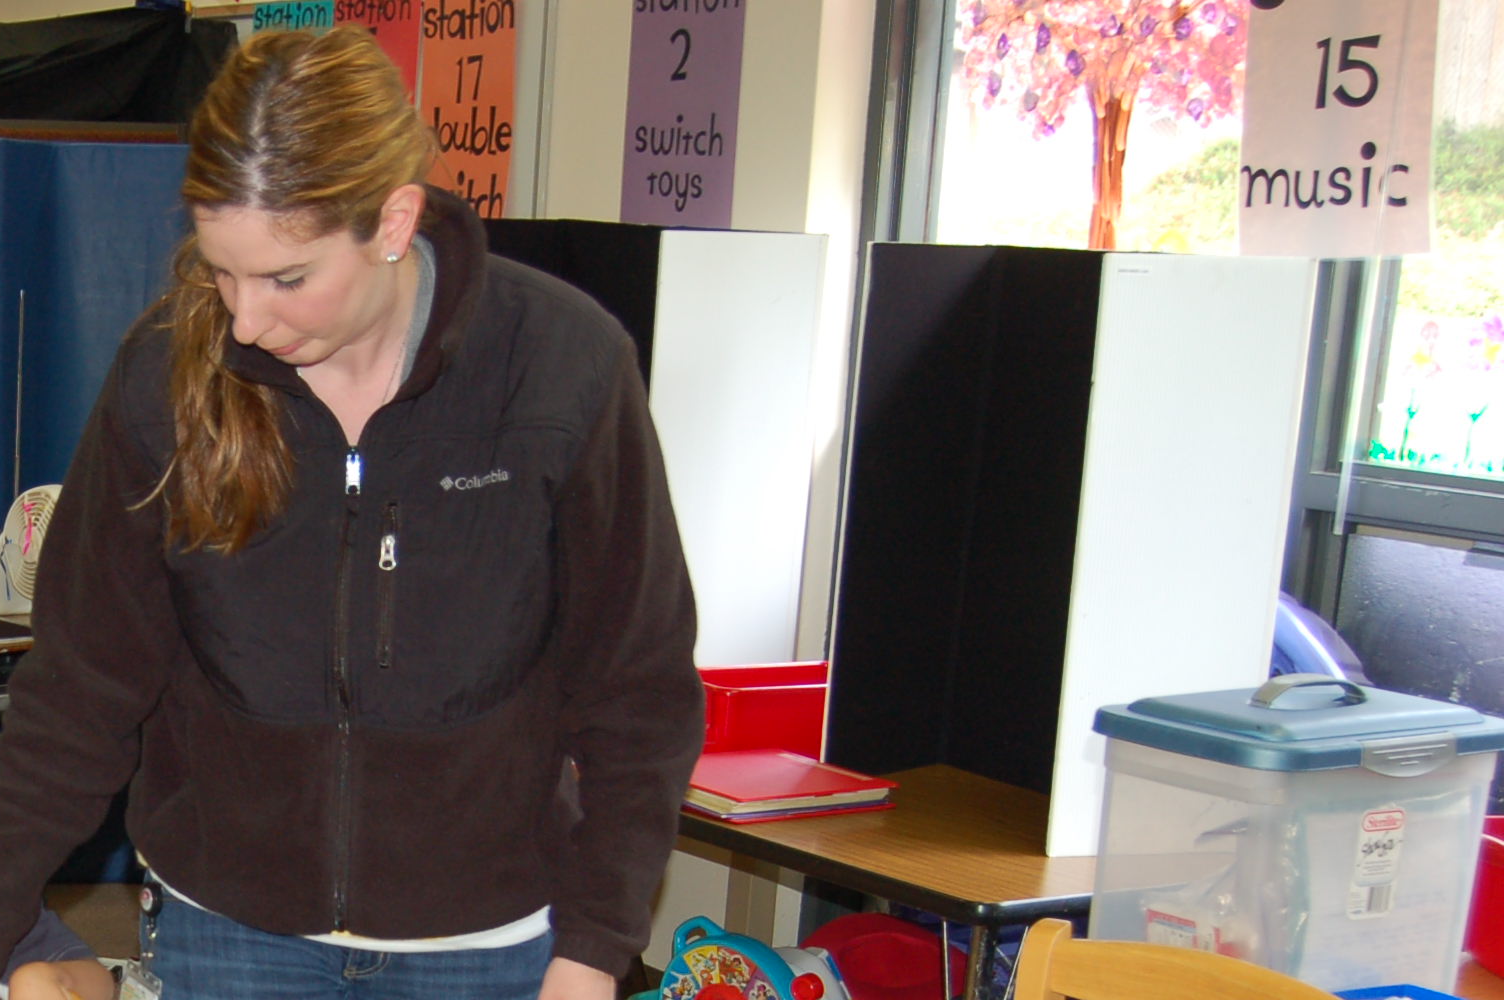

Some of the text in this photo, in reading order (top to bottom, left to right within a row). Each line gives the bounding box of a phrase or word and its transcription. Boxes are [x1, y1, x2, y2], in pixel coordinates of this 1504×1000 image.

[254, 2, 327, 29] station
[423, 0, 514, 39] station
[670, 28, 691, 81] 2
[1315, 34, 1381, 110] 15
[456, 55, 483, 103] 17
[635, 112, 724, 156] switch
[647, 170, 703, 212] toys
[1240, 141, 1409, 209] music
